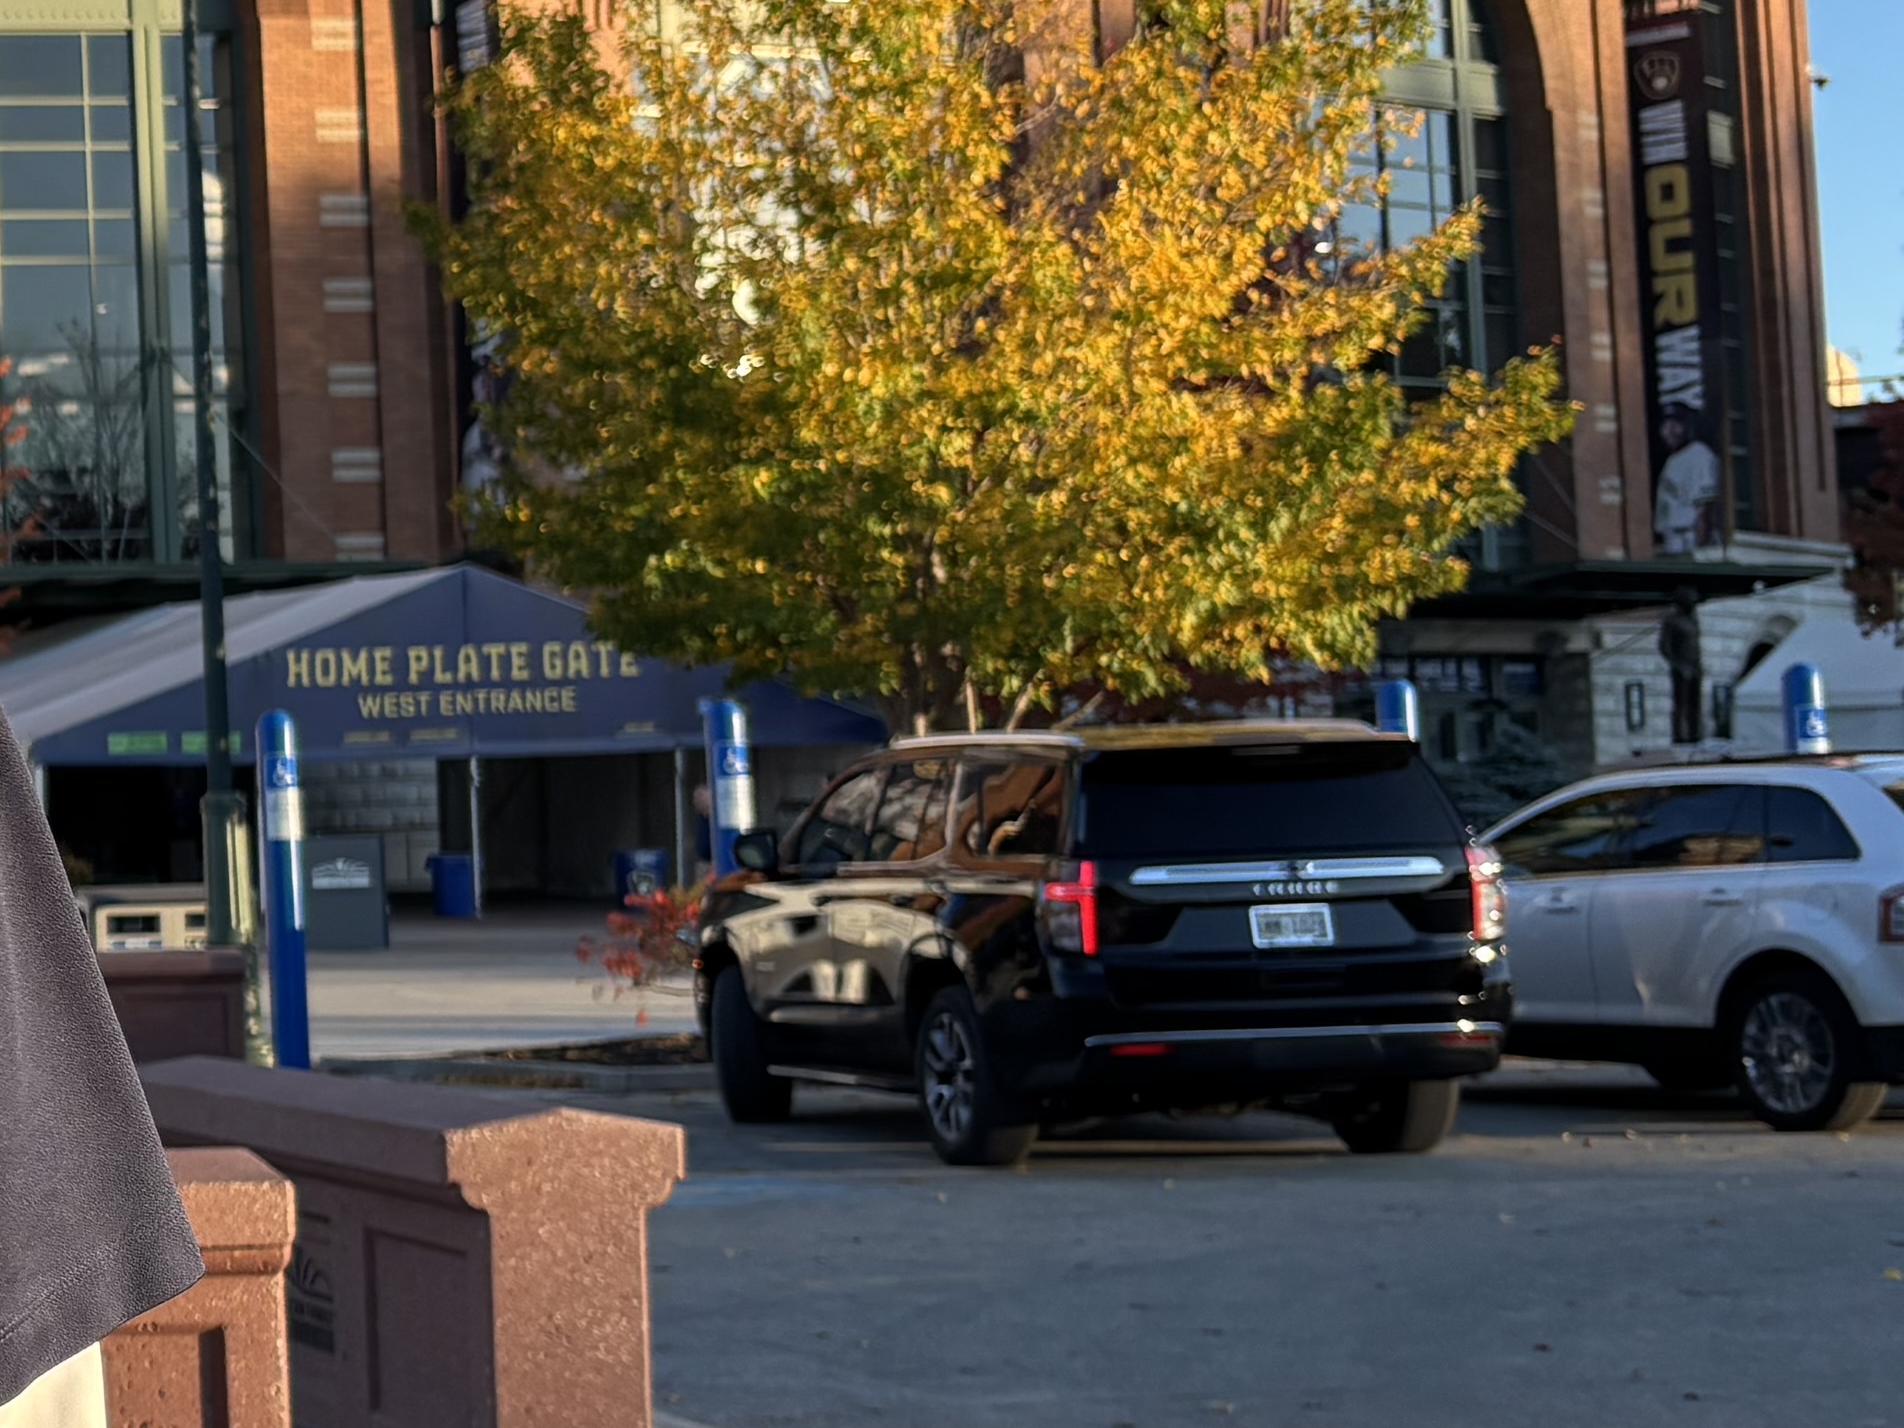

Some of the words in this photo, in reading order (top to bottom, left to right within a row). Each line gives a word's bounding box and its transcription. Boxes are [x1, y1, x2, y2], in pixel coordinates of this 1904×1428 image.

[1644, 164, 1697, 329] OUR
[286, 645, 395, 689] HOME
[406, 640, 532, 686] PLATE
[357, 690, 432, 720] WEST
[438, 685, 579, 714] ENTRANCE
